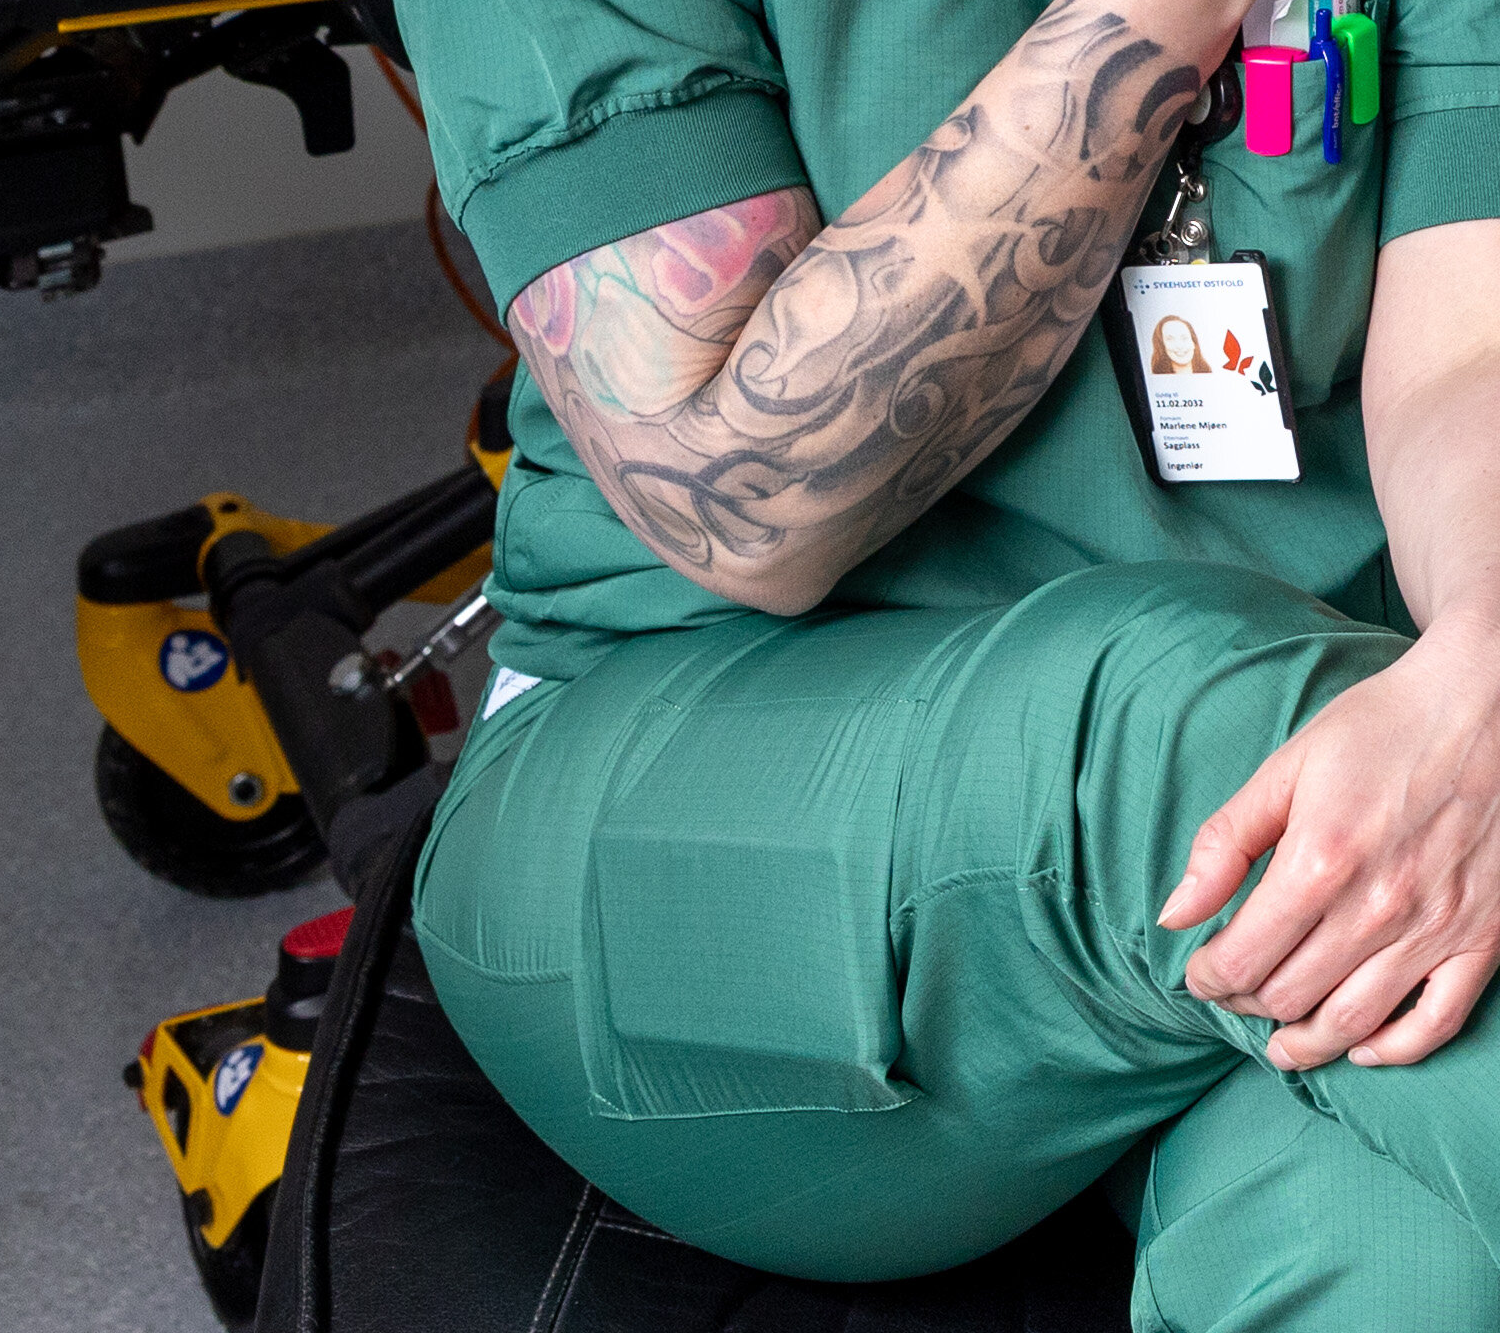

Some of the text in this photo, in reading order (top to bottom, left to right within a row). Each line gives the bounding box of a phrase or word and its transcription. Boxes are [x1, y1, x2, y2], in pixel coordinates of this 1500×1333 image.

[1153, 279, 1244, 289] SYKEHUSET ØSTFOLD
[1156, 399, 1204, 408] 11.02.2032
[1160, 421, 1228, 432] Marlene Mjøen
[1163, 441, 1201, 451] Sagplass
[1167, 462, 1204, 471] Ingeniør
